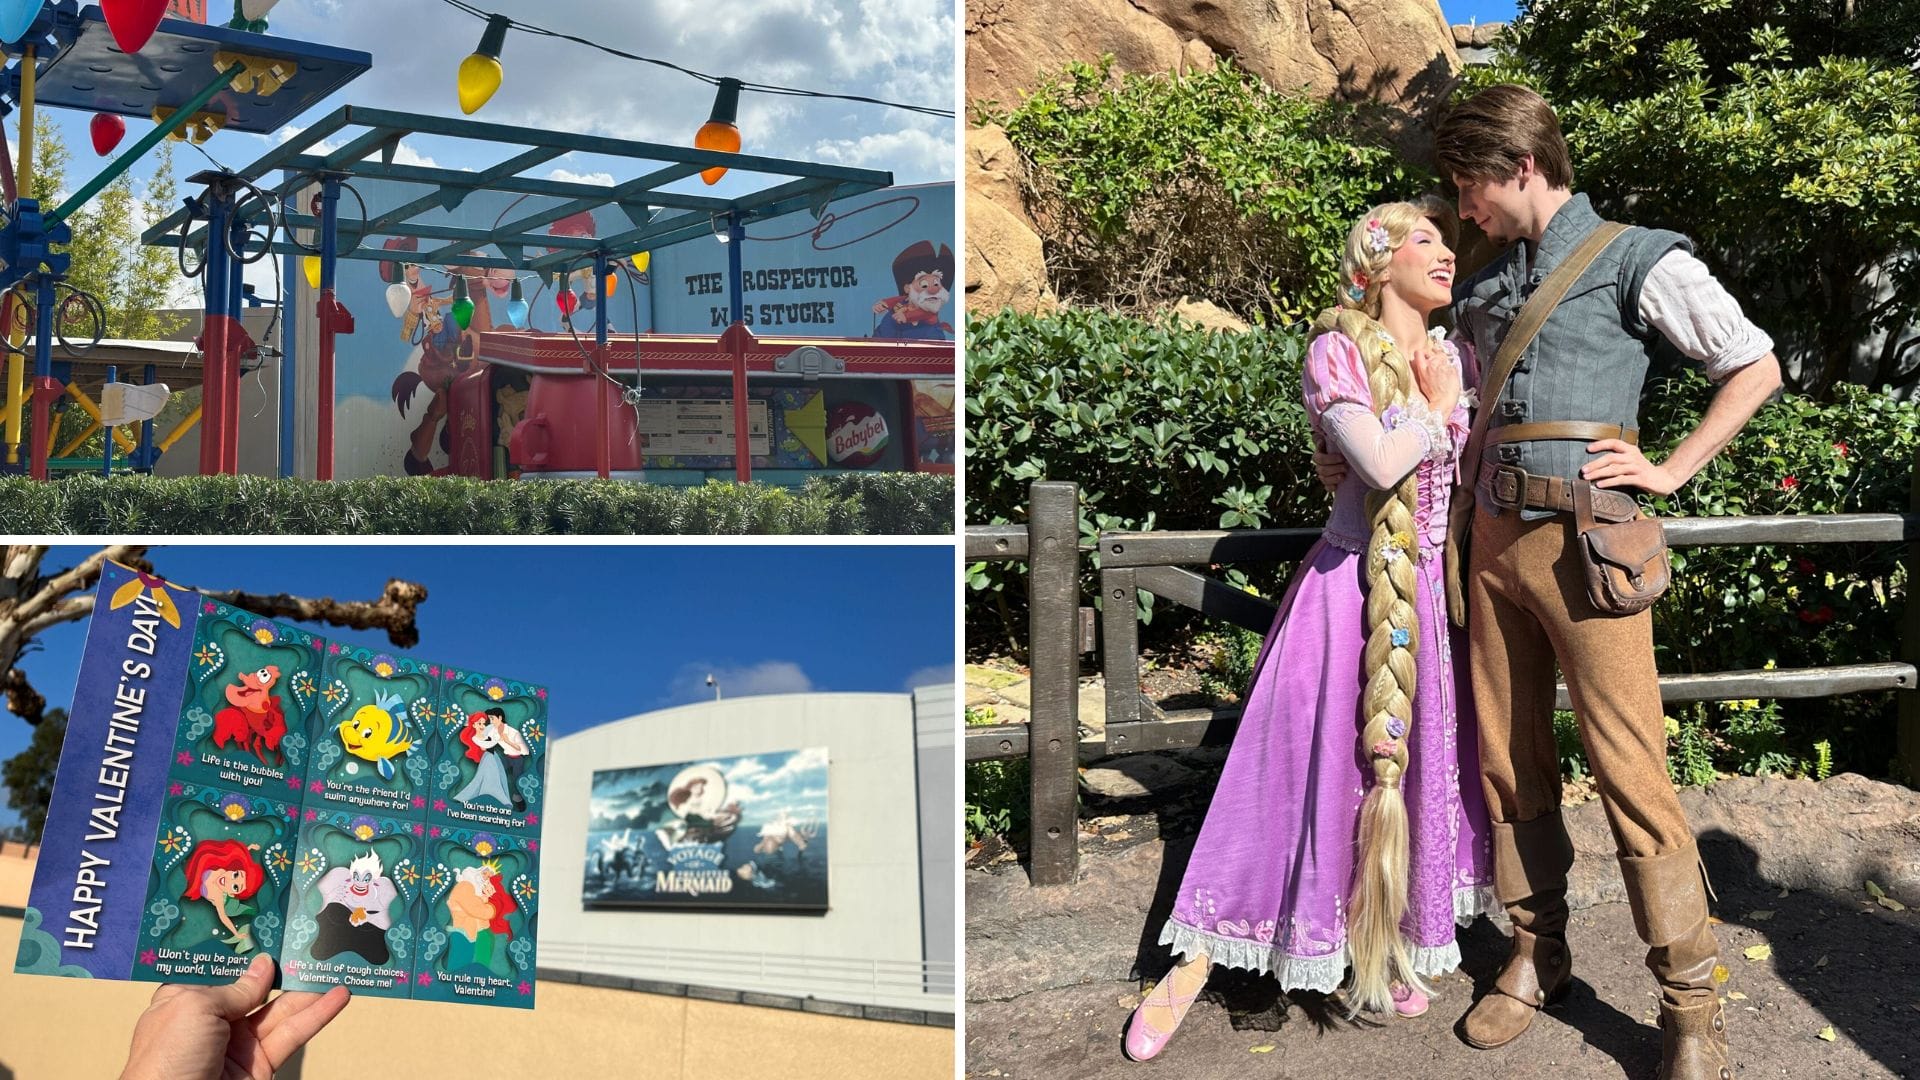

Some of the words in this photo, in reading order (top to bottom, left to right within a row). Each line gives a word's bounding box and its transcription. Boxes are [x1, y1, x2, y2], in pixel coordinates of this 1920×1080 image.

[685, 272, 723, 296] THE
[742, 265, 858, 292] ROSPECTOR
[710, 305, 753, 327] WS
[760, 301, 834, 326] STUCK!
[834, 417, 884, 455] Babybel
[127, 594, 164, 655] DAY!
[84, 659, 151, 841] VALENTINE'S
[201, 753, 221, 765] Life
[223, 758, 231, 768] is
[233, 761, 249, 772] the
[250, 764, 284, 780] bubbles
[220, 770, 241, 782] with
[243, 776, 263, 787] you!
[326, 780, 353, 791] You're
[355, 785, 370, 794] the
[372, 787, 398, 799] friend
[400, 791, 411, 800] I'd
[324, 792, 346, 802] swim
[348, 795, 390, 807] anywhere
[392, 801, 409, 811] for!
[463, 800, 485, 812] You're
[486, 804, 498, 813] the
[498, 808, 512, 816] one
[446, 808, 460, 818] I've
[460, 811, 478, 821] been
[478, 816, 511, 828] searching
[511, 818, 526, 828] for!
[667, 848, 726, 866] VOYAGE
[63, 850, 111, 948] HAPPY
[158, 947, 190, 960] Won't
[192, 953, 211, 964] you
[213, 953, 225, 963] be
[227, 956, 249, 966] part
[156, 963, 171, 975] my
[289, 960, 313, 970] Life's
[316, 962, 331, 972] full
[333, 963, 345, 973] of
[346, 965, 372, 976] tough
[344, 975, 375, 987] Choose
[376, 979, 393, 988] me!
[437, 970, 452, 981] You
[454, 973, 472, 983] rule
[473, 976, 486, 987] my
[488, 975, 513, 988] heart,
[454, 983, 496, 998] Valentine!
